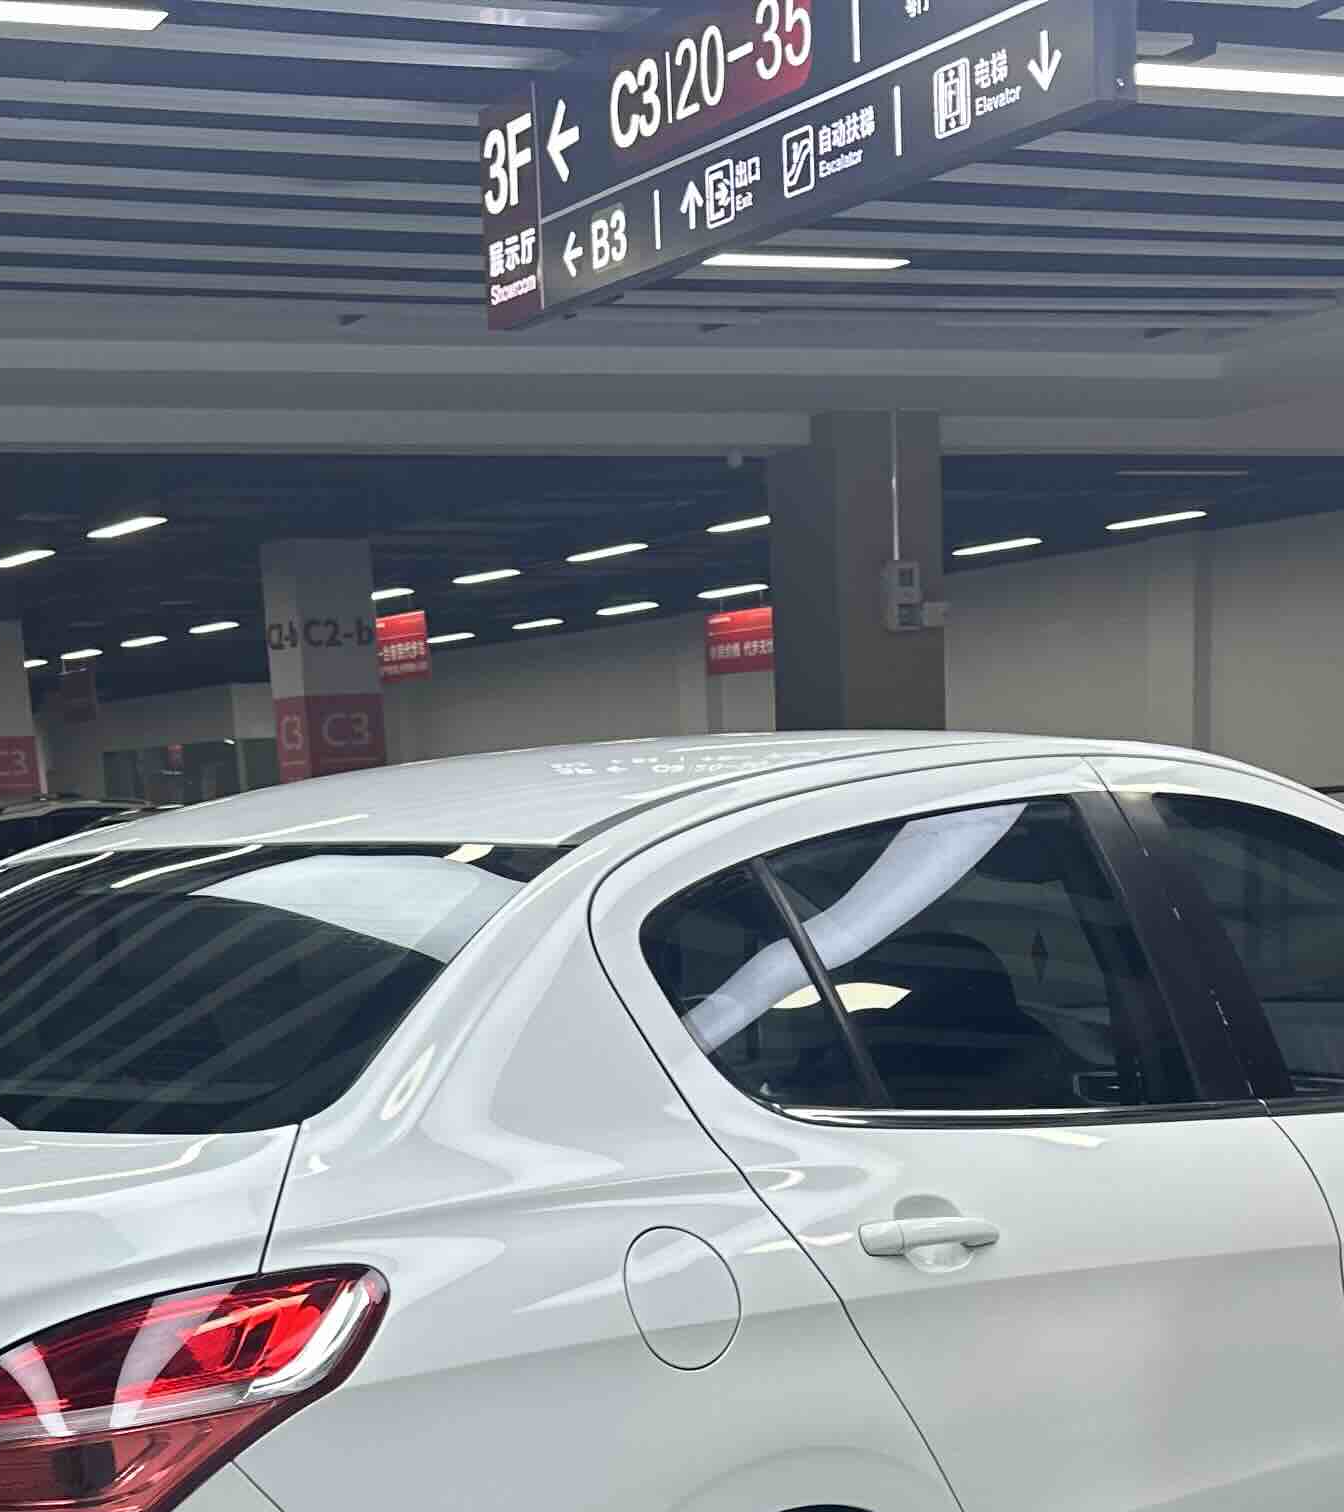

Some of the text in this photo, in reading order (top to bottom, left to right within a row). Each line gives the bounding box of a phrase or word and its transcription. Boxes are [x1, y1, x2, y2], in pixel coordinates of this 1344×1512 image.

[974, 48, 1009, 88] 电梯
[974, 85, 1023, 116] Elevator
[817, 104, 876, 155] 自动扶梯
[483, 111, 533, 216] 3F
[734, 155, 762, 190] 出口
[817, 149, 864, 179] Escalator
[734, 191, 754, 212] Exit
[488, 226, 536, 278] 展示厅
[591, 208, 628, 270] B3
[321, 711, 371, 747] C3
